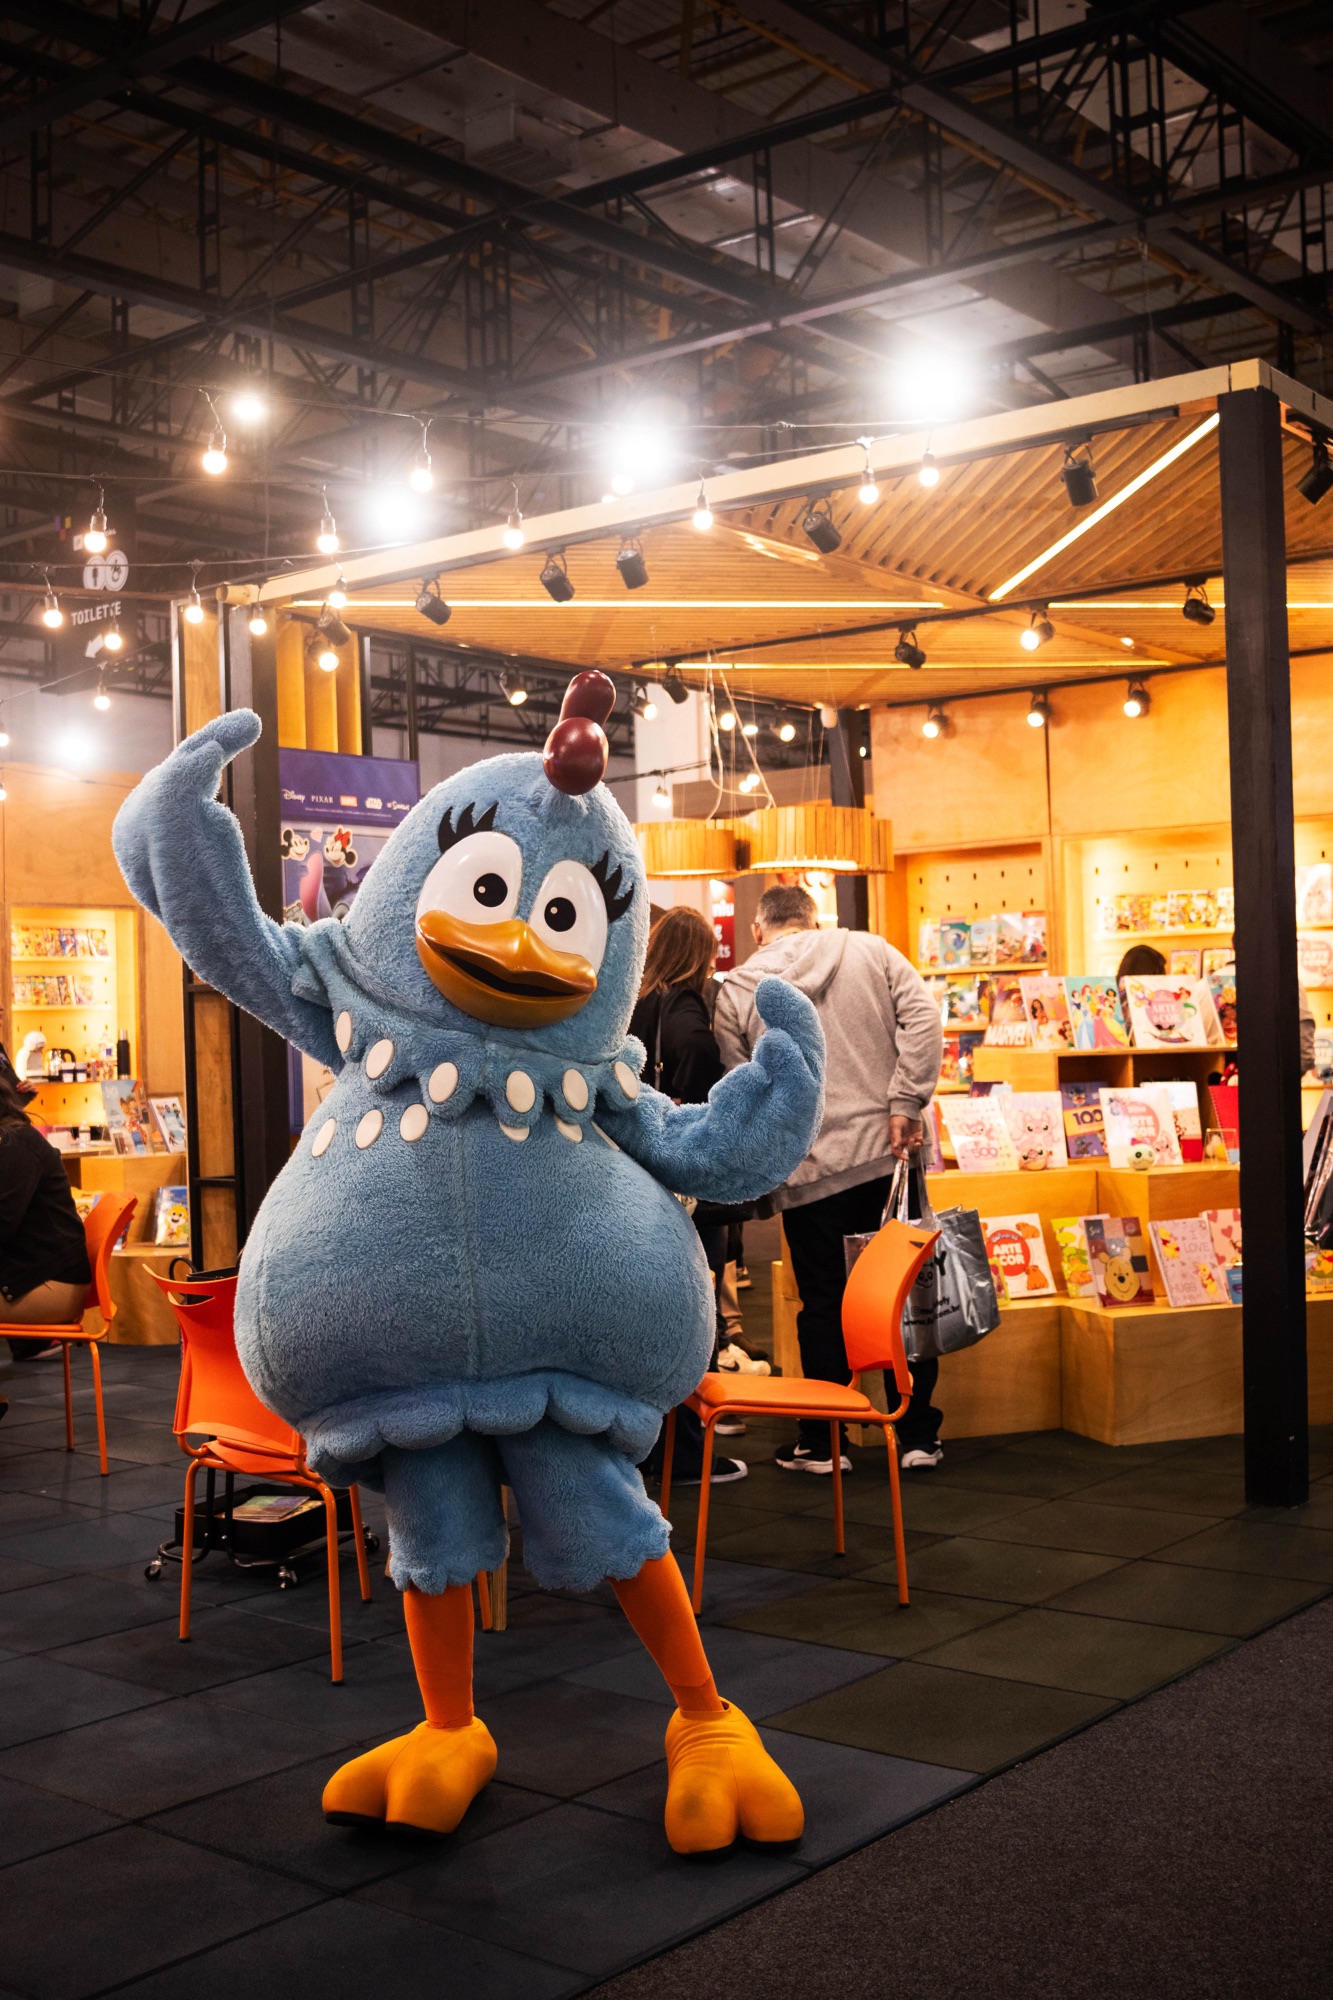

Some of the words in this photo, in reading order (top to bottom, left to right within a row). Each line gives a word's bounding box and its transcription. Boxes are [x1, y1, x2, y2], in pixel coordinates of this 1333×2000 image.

[282, 788, 306, 803] Disney
[311, 794, 334, 804] PIXAR
[983, 1023, 1027, 1046] MARVEL
[993, 1243, 1024, 1256] ARTE
